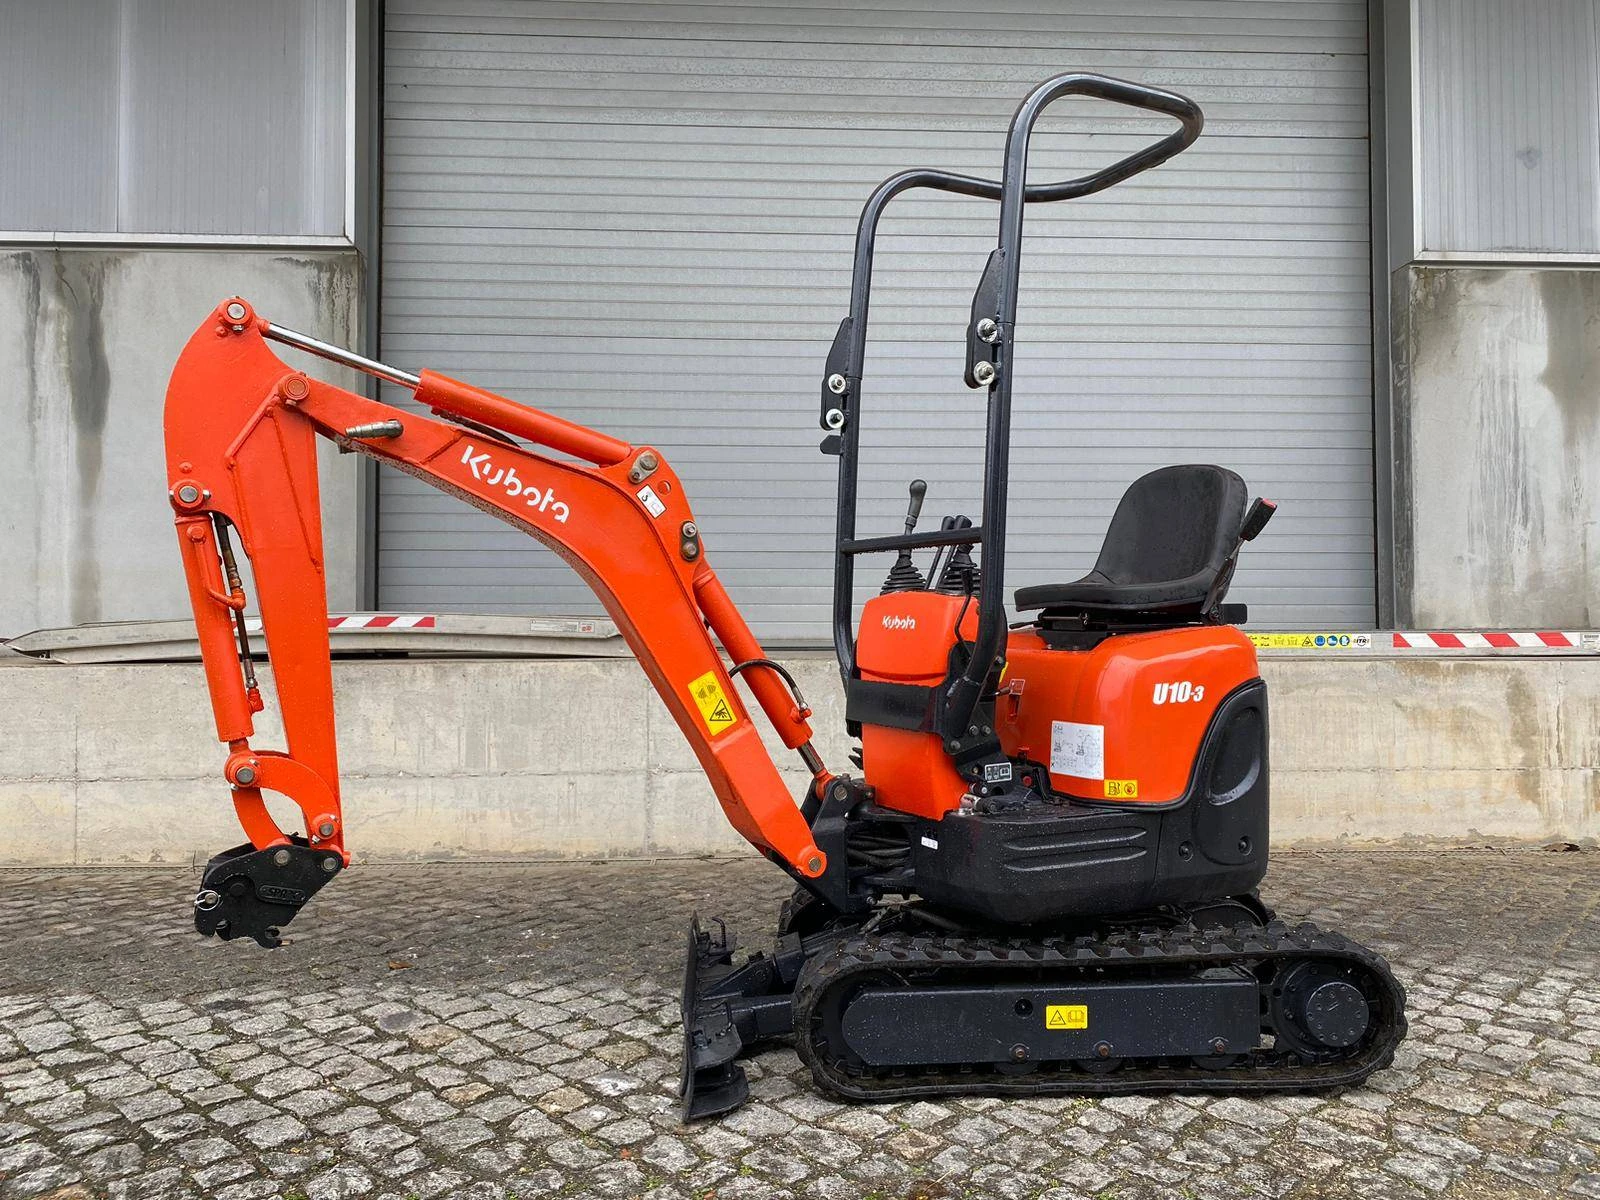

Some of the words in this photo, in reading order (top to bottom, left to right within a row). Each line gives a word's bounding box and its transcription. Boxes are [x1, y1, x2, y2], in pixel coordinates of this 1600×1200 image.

[461, 445, 570, 523] Kubota
[882, 615, 916, 629] Kubota
[1152, 681, 1205, 705] U10-3
